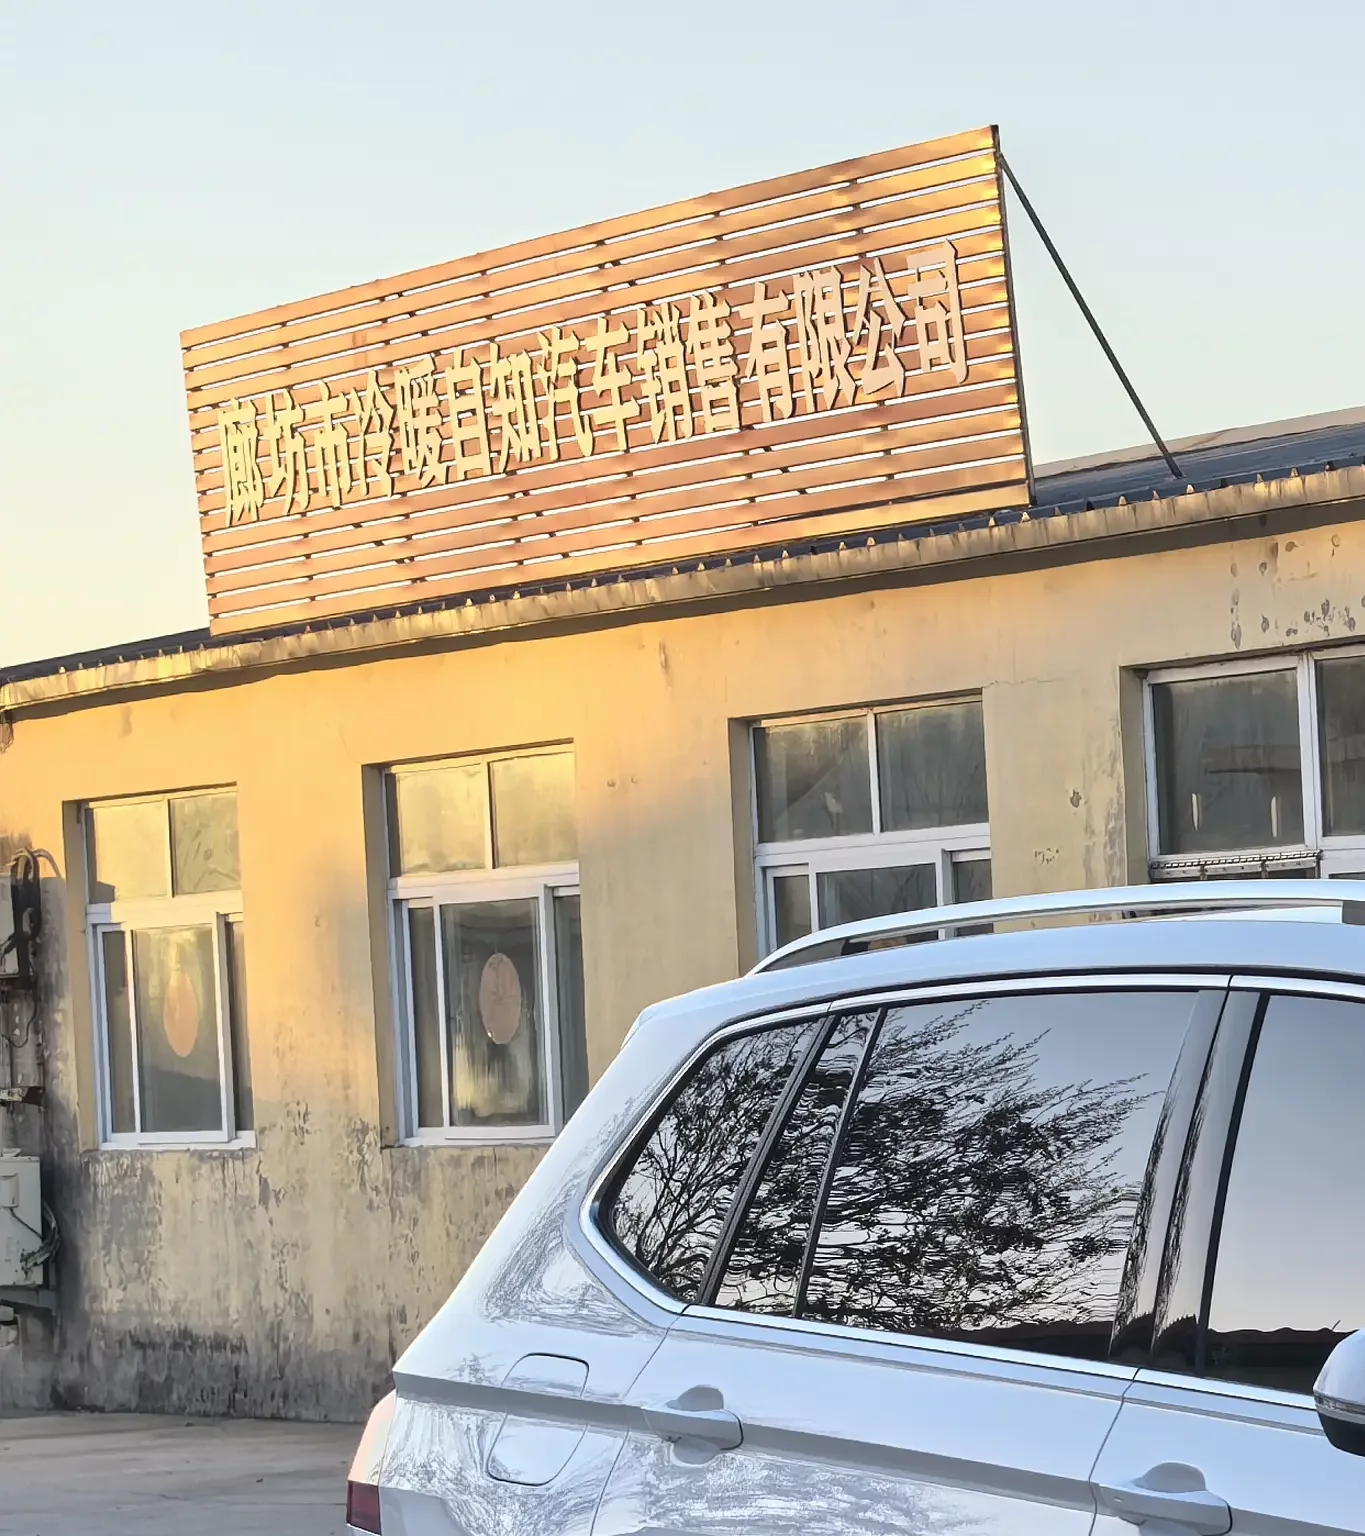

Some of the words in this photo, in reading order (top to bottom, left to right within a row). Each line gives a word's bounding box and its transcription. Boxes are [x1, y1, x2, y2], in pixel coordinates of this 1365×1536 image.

[217, 239, 968, 527] 廊坊市冷暖自知汽车销售有限公司
